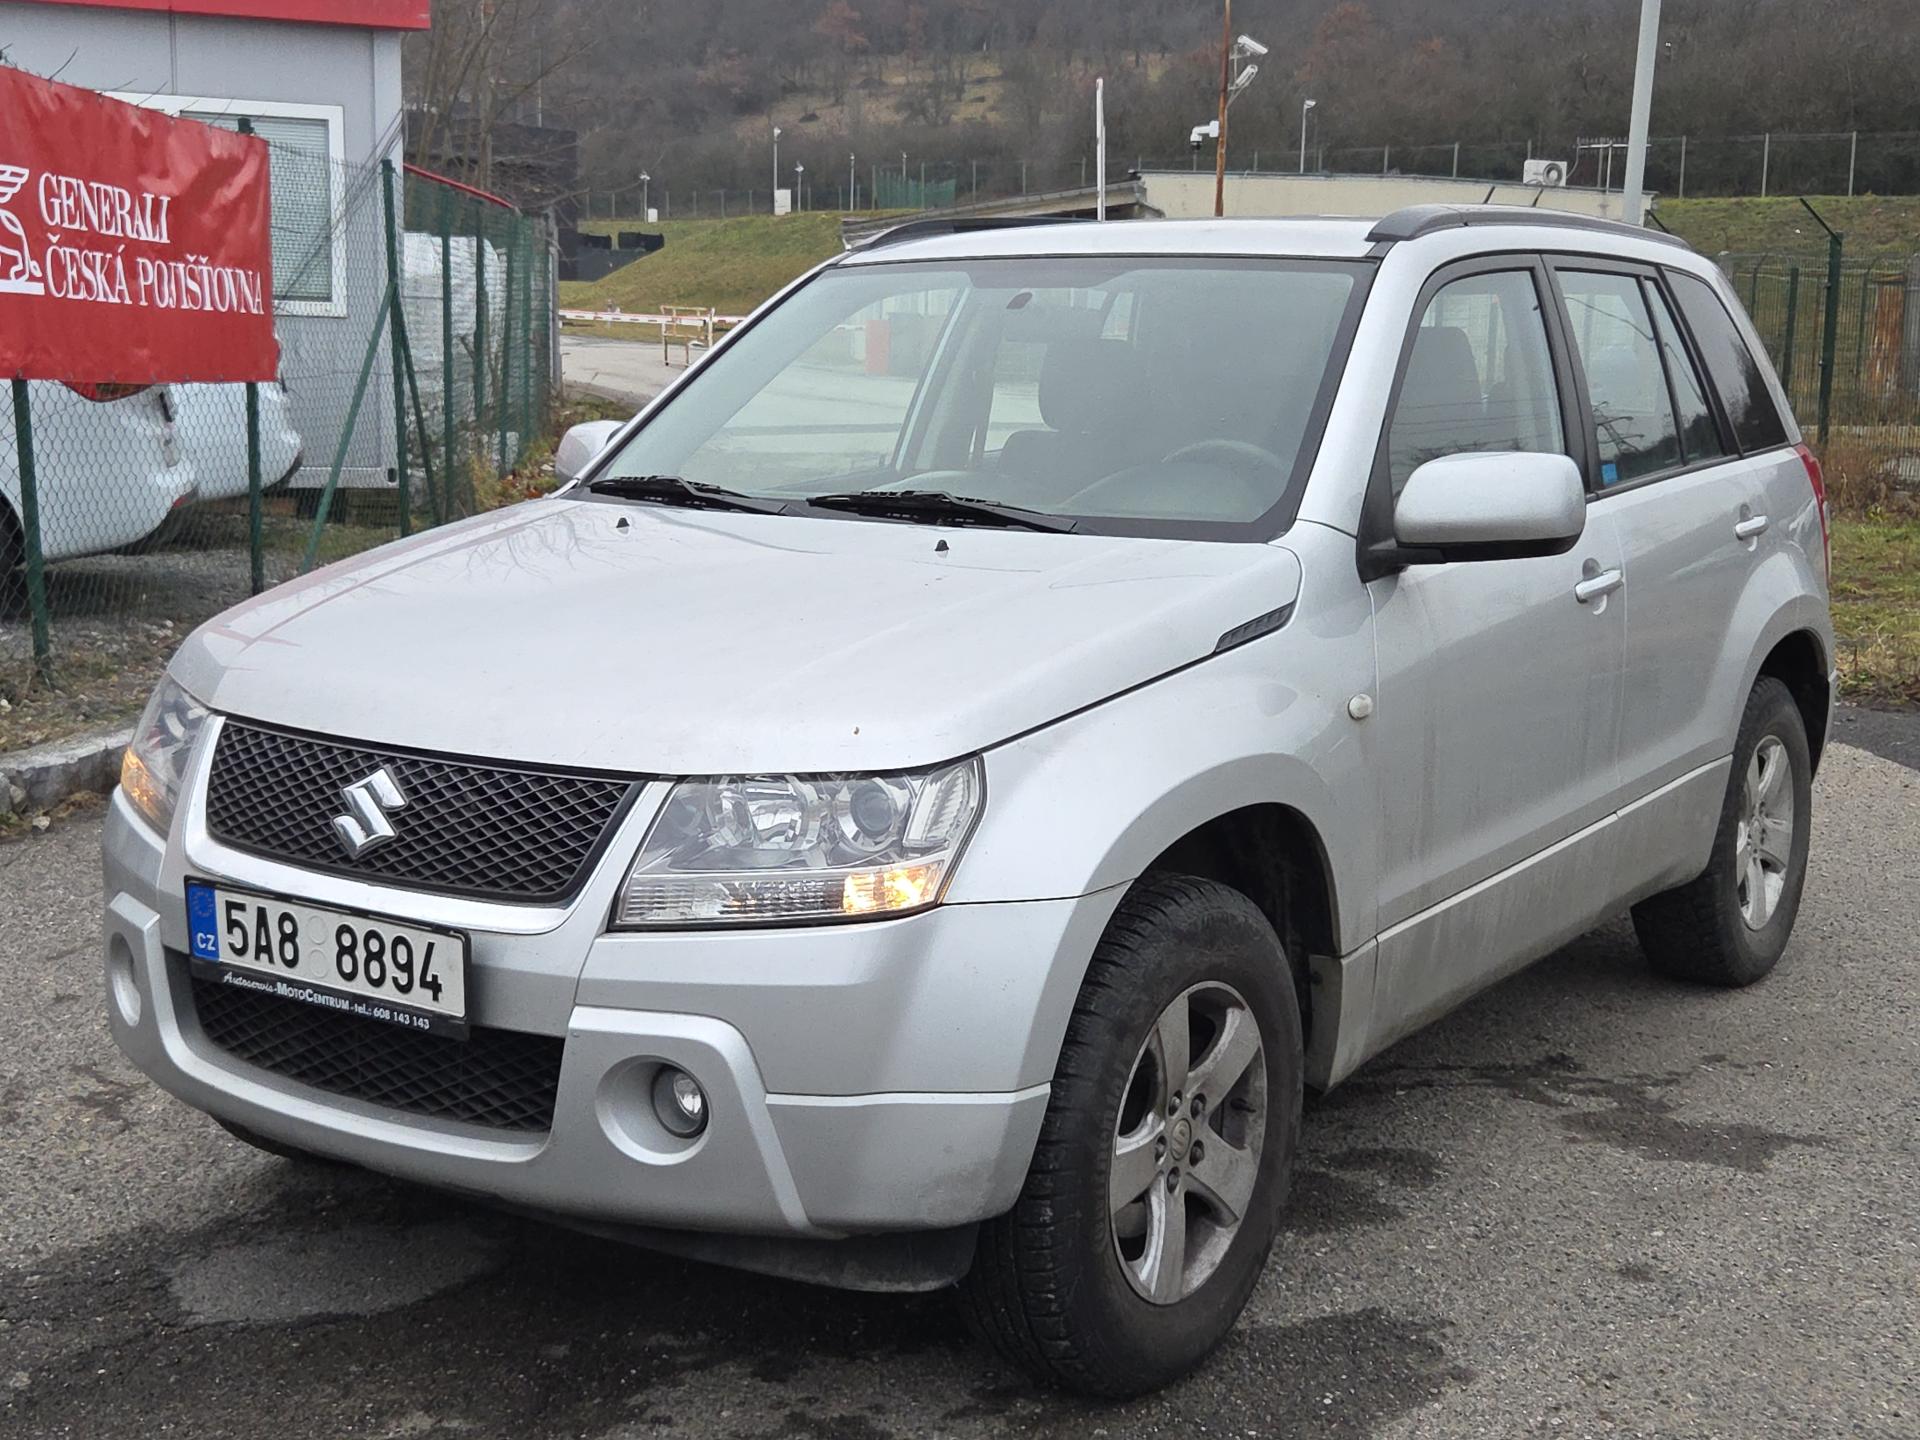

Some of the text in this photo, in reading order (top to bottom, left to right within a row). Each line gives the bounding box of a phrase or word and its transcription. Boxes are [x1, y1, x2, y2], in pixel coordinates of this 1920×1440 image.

[38, 172, 171, 244] GENERALI
[45, 232, 265, 315] ČESKÁ POJIŠŤOVNA
[196, 932, 216, 951] CZ
[225, 899, 443, 1002] 5A8 8894
[373, 1007, 390, 1020] 608
[393, 1011, 410, 1025] 143
[413, 1016, 430, 1030] 143
